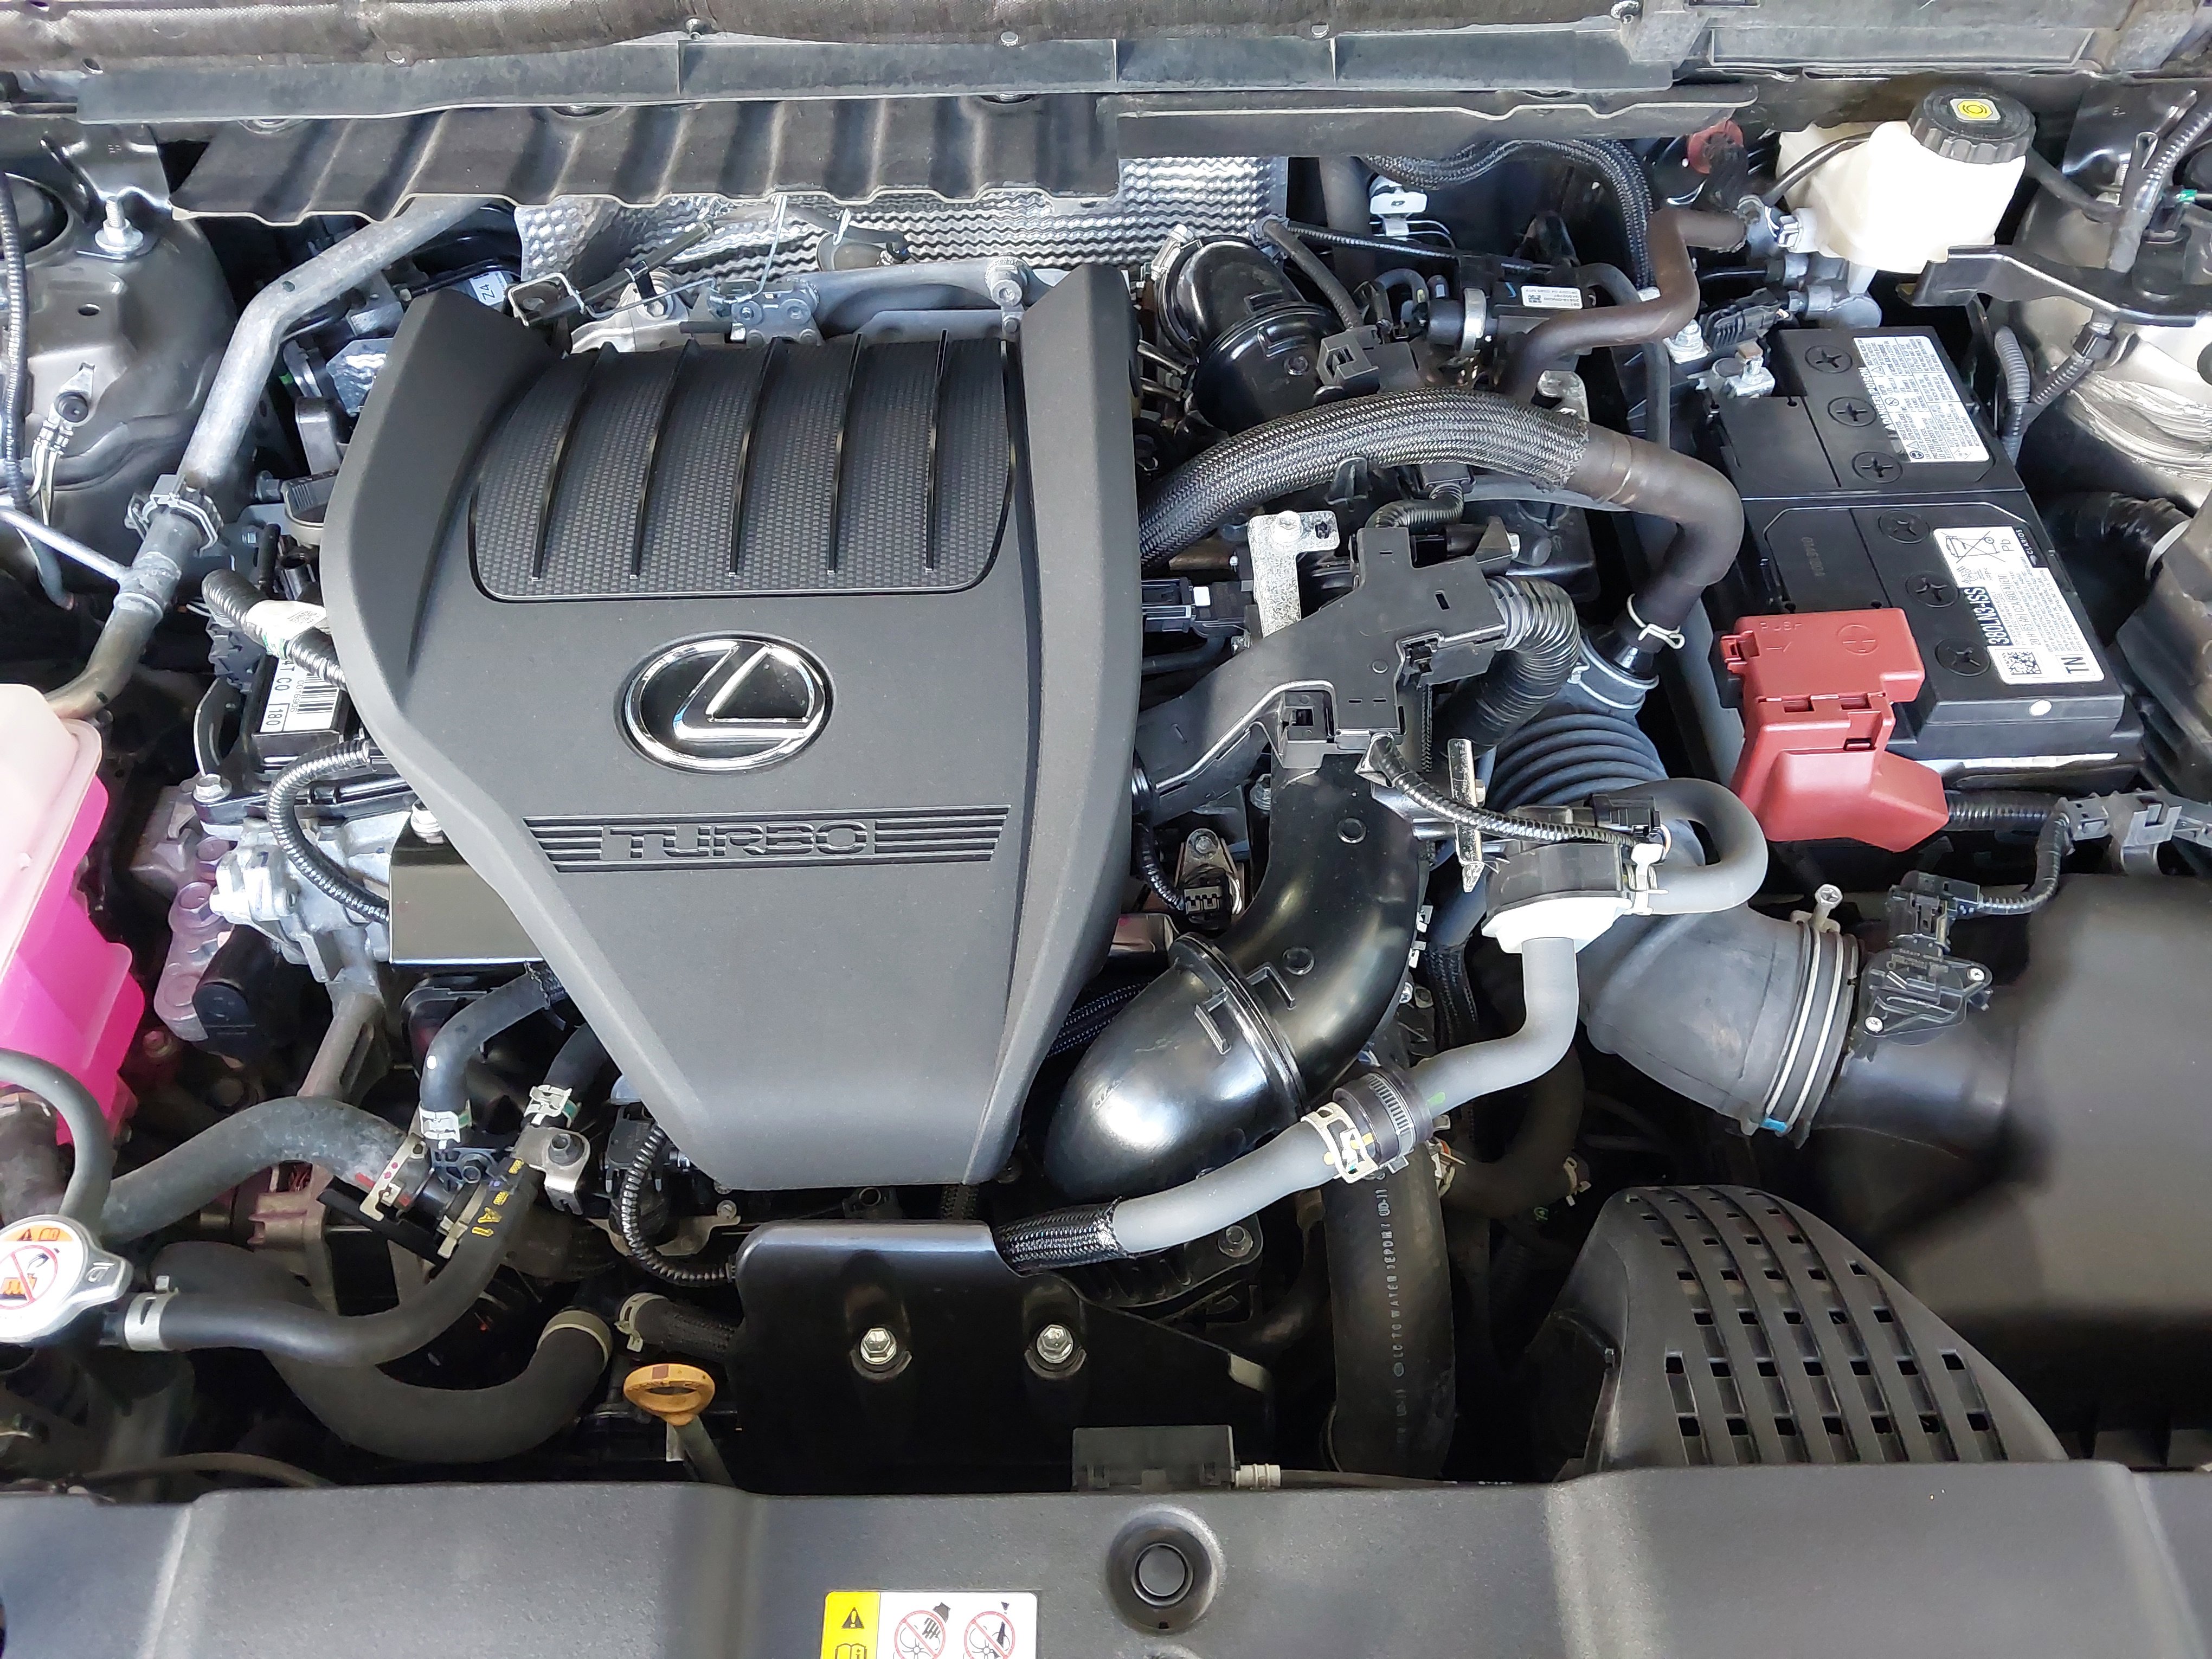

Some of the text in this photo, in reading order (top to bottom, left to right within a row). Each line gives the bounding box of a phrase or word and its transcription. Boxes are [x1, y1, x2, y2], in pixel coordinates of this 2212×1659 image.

[2001, 539, 2015, 552] Pb
[2016, 529, 2034, 556] CLARIOS
[1963, 587, 2010, 646] 380LN3-ISS
[2061, 656, 2090, 674] TN
[290, 680, 305, 712] 0016906
[266, 709, 284, 725] 180
[609, 820, 869, 859] TURBO
